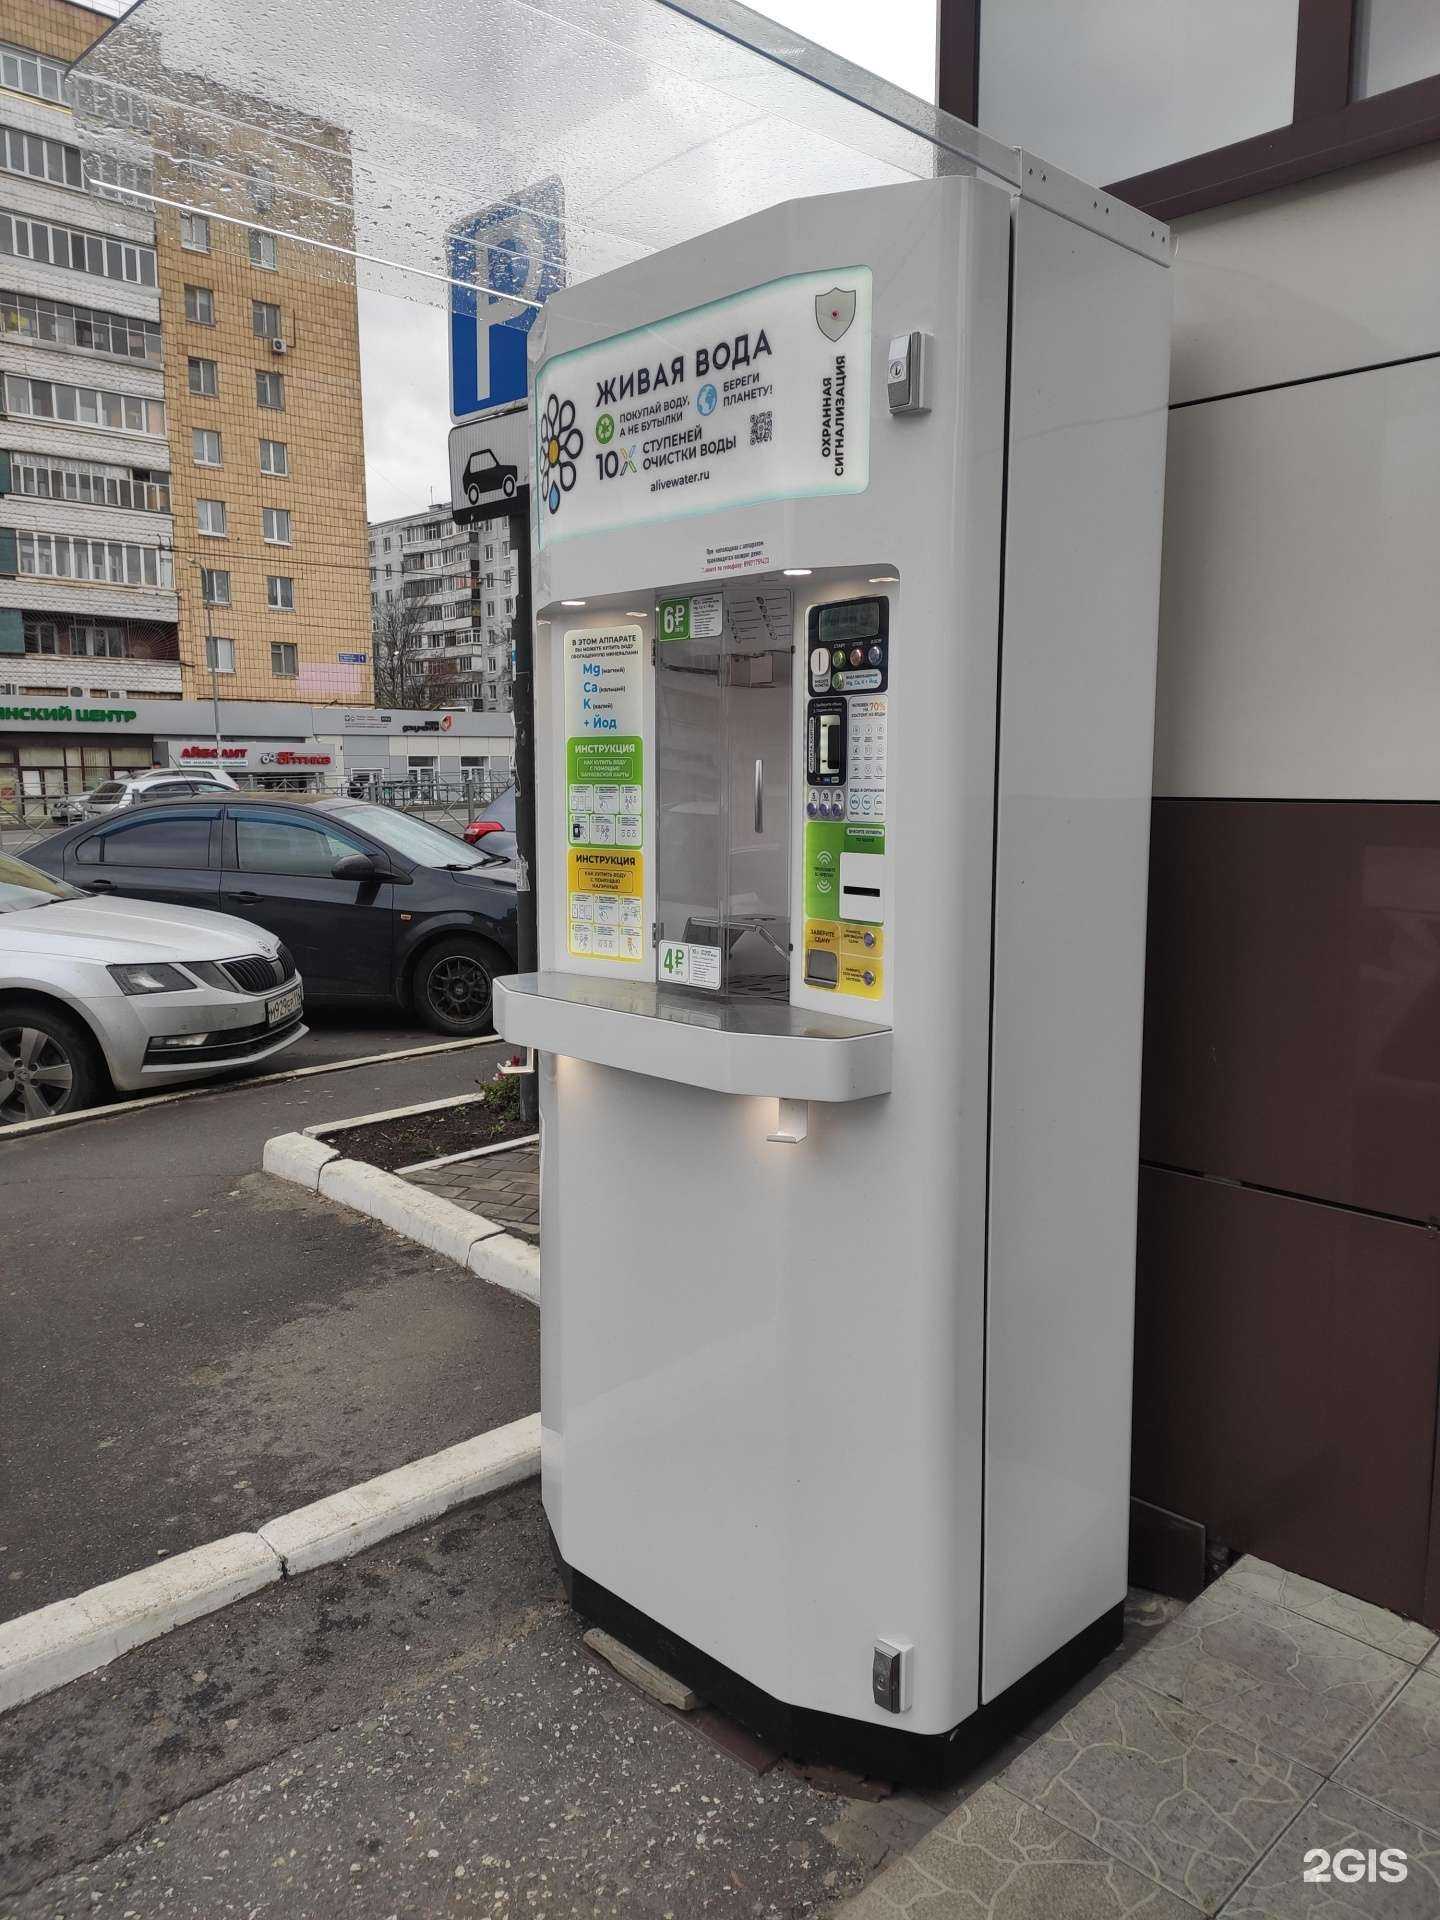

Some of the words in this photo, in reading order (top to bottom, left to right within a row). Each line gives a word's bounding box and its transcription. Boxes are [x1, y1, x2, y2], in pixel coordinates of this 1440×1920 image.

[596, 356, 684, 407] ЖИВАЯ
[695, 329, 772, 377] ВОДА
[723, 373, 760, 392] БЕРЕГИ
[723, 385, 772, 407] ПЛАНЕТУ!
[620, 401, 662, 423] ПОКУПАЙ
[664, 396, 690, 413] ВОДУ,
[822, 377, 832, 457] ОХРАННАЯ
[835, 355, 847, 476] СИГНАЛИЗАЦИЯ
[620, 429, 626, 438] А
[628, 425, 639, 436] НЕ
[641, 411, 683, 431] БУТЫЛКИ
[643, 424, 702, 453] СТУПЕНЕЙ
[643, 445, 697, 471] ОЧИСТКИ
[700, 436, 736, 456] ВОДЫ
[650, 471, 710, 492] alivewater.ru
[578, 638, 597, 646] ЭТОМ
[599, 635, 636, 644] АППАРАТЕ
[583, 664, 601, 676] Mg
[583, 682, 598, 693] Ca
[75, 709, 137, 723] ЦЕНТР
[593, 714, 617, 729] Йод
[575, 743, 636, 754] ИНСТРУКЦИЯ
[576, 854, 636, 866] ИНСТРУКЦИЯ
